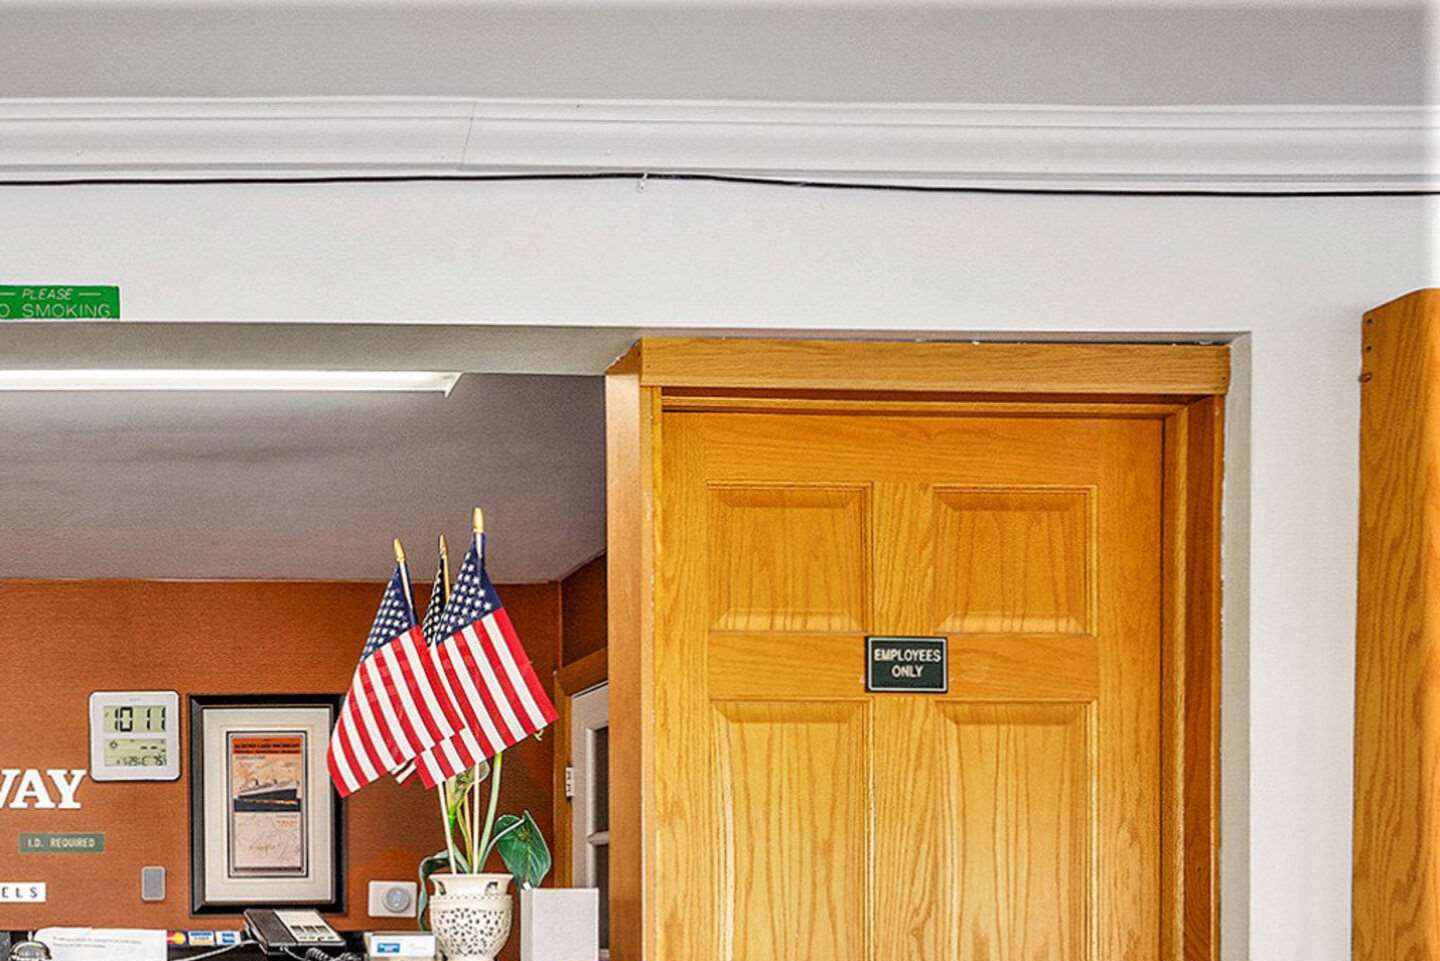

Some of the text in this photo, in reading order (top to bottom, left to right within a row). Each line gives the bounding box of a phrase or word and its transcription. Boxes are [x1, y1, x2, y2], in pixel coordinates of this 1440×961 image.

[21, 287, 74, 300] PLEASE
[21, 303, 111, 317] SMOKING
[873, 648, 942, 663] EMPLOYEES
[891, 664, 924, 678] ONLY
[49, 837, 96, 848] REQUIRED
